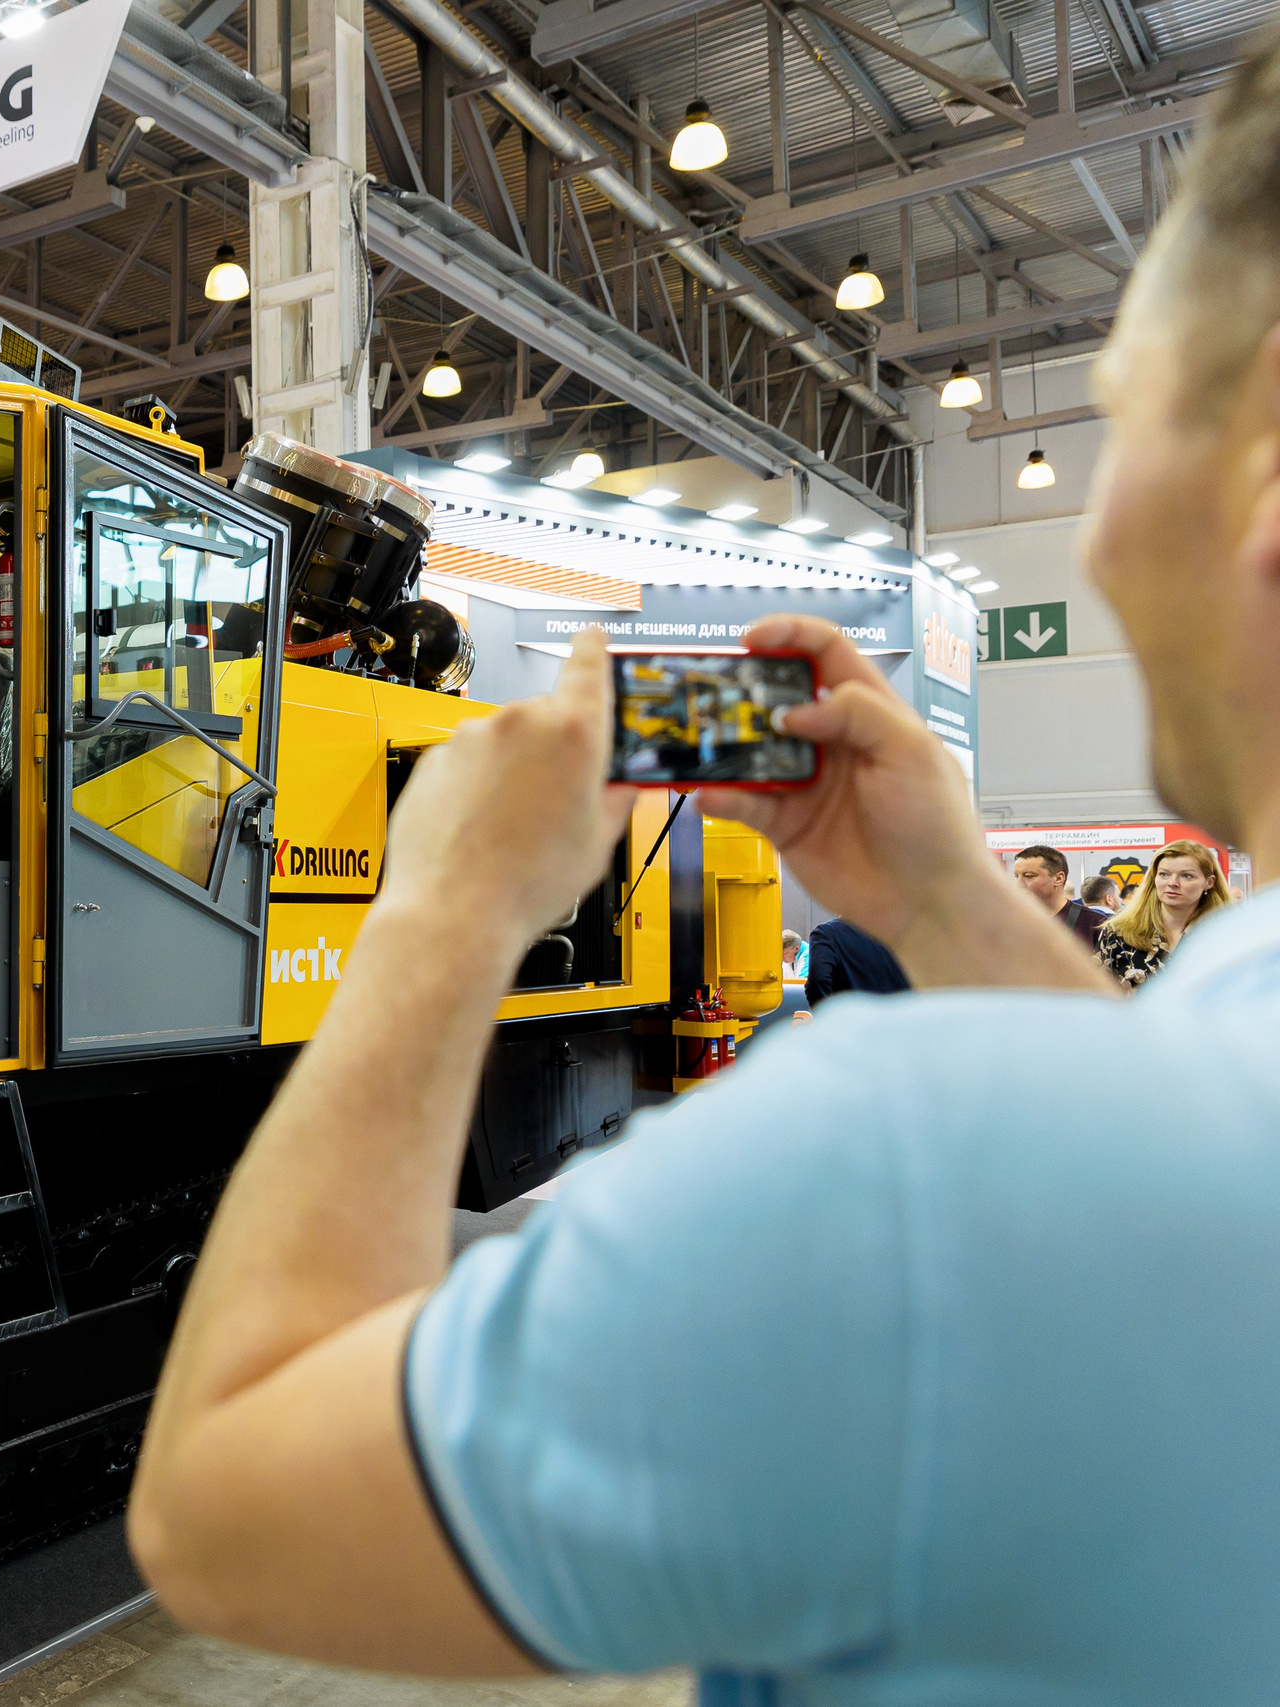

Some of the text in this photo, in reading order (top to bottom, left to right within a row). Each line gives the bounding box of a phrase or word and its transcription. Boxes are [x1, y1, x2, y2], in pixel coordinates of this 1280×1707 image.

[634, 622, 696, 636] РЕШЕНИЯ
[698, 623, 726, 638] ДЛЯ
[841, 626, 887, 642] ПОРОД
[290, 846, 369, 878] DRILLING
